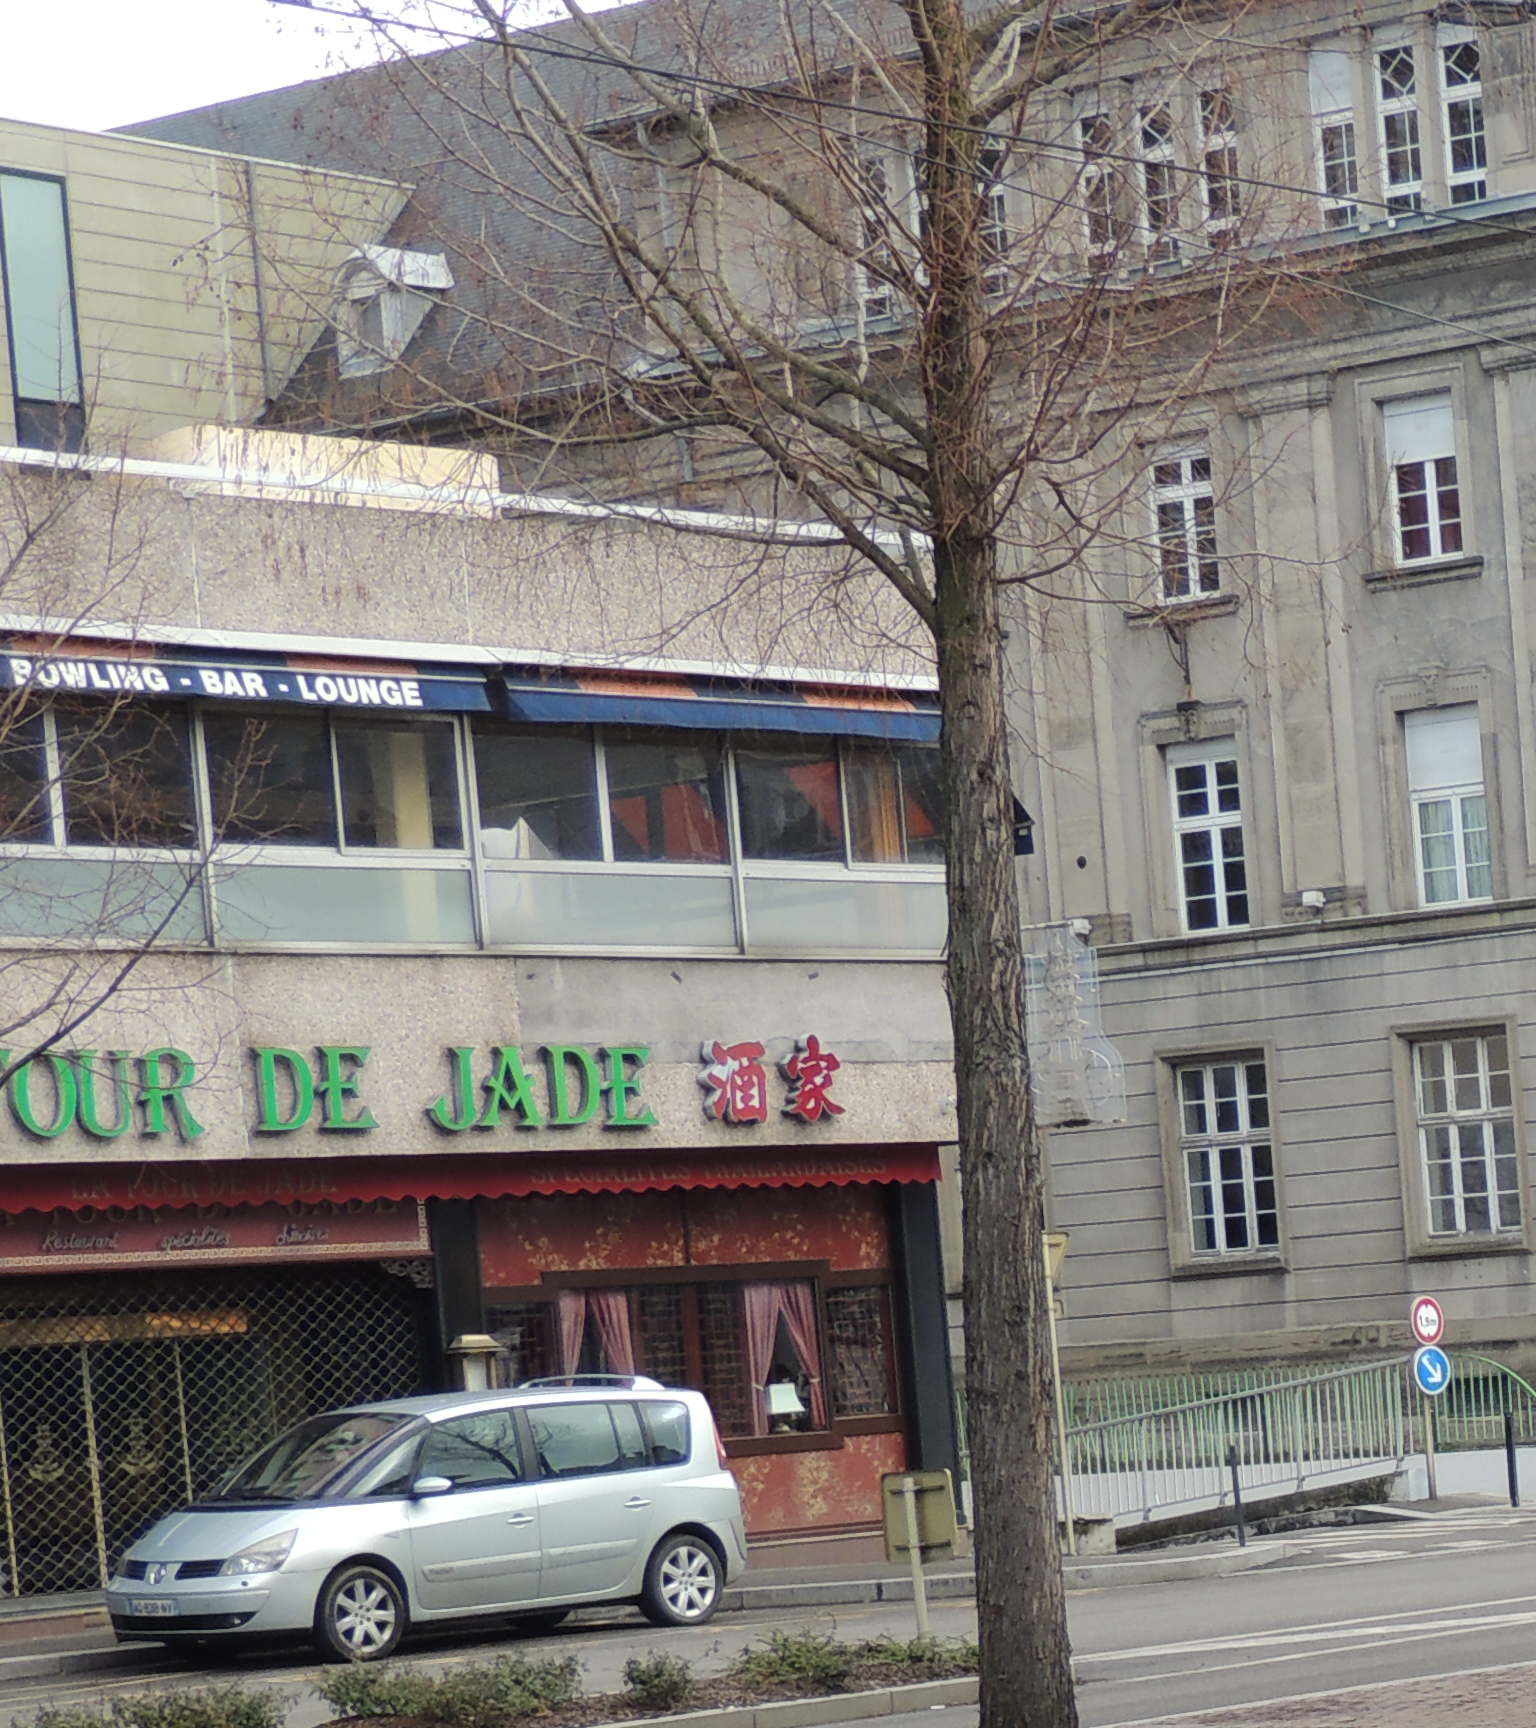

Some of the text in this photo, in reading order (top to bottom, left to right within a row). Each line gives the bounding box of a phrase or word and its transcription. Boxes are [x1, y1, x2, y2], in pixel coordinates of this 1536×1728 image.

[9, 658, 171, 692] BOWLING
[198, 669, 270, 699] BAR
[296, 675, 425, 707] LOUNGE
[0, 1045, 660, 1142] OUR DE JADE
[698, 1033, 846, 1124] 酒家
[255, 1167, 338, 1195] JADE
[42, 1231, 120, 1252] Restaurant
